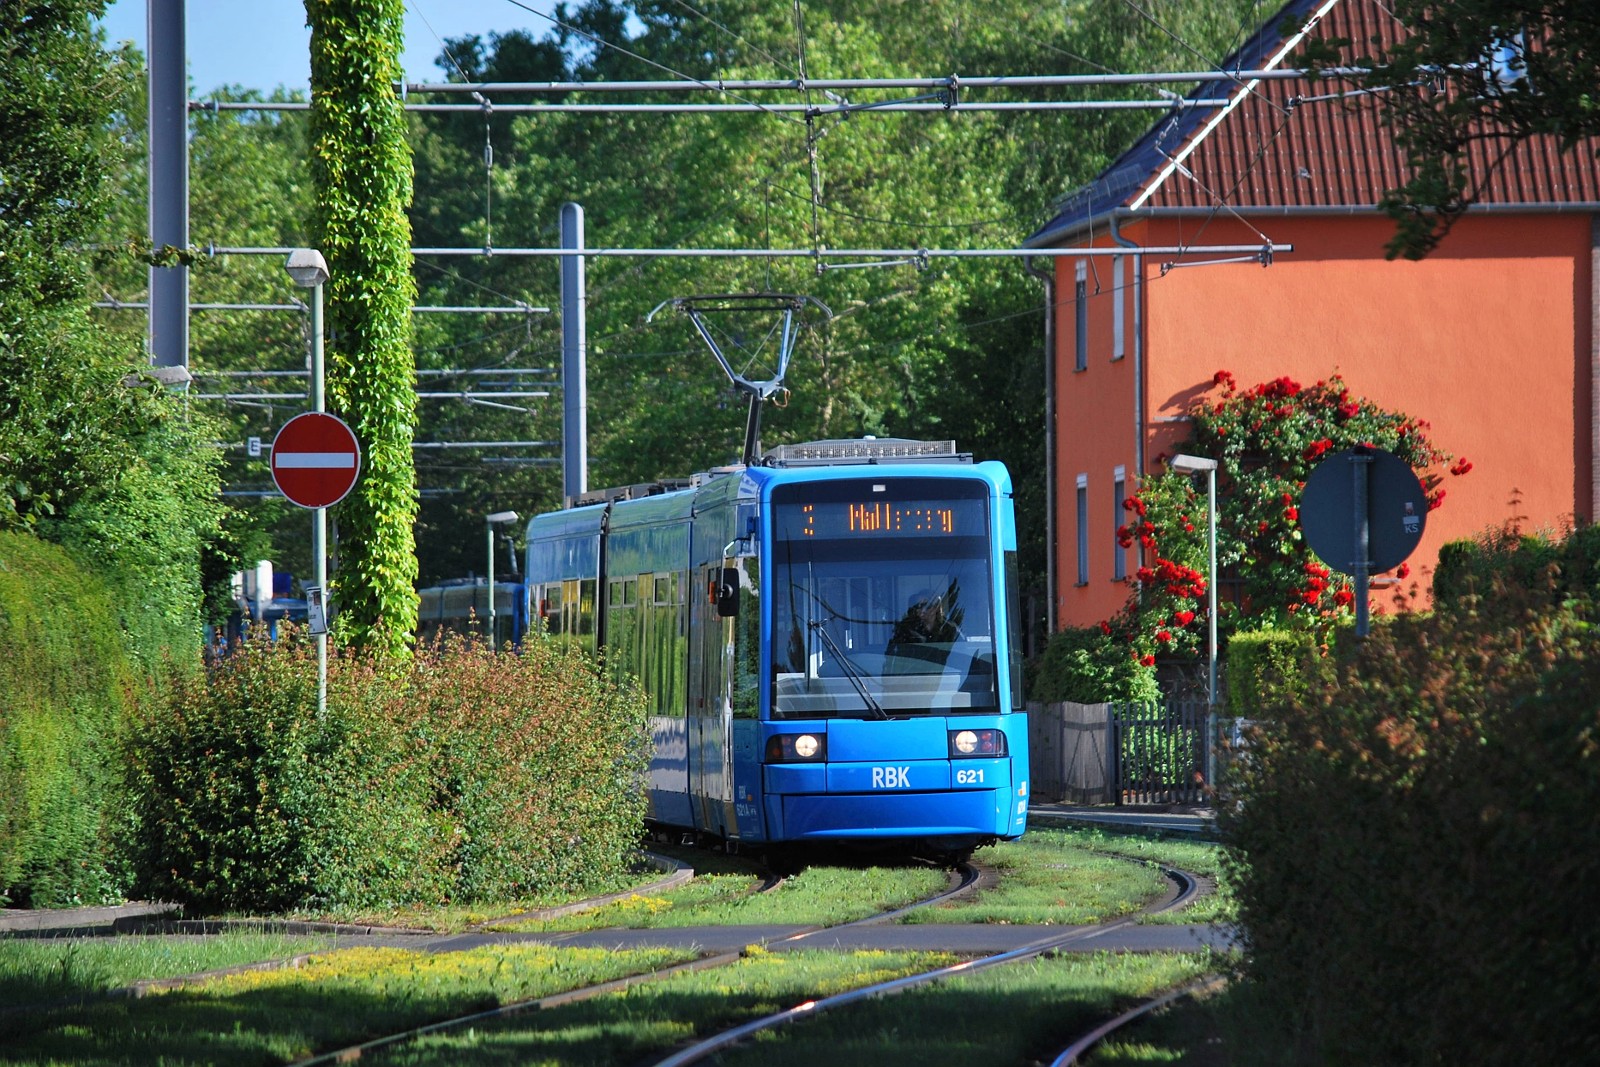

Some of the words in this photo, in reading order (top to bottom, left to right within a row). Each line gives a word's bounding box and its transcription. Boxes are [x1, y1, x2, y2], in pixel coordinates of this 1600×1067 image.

[251, 440, 259, 452] E
[872, 766, 911, 788] RBK
[956, 769, 985, 784] 621
